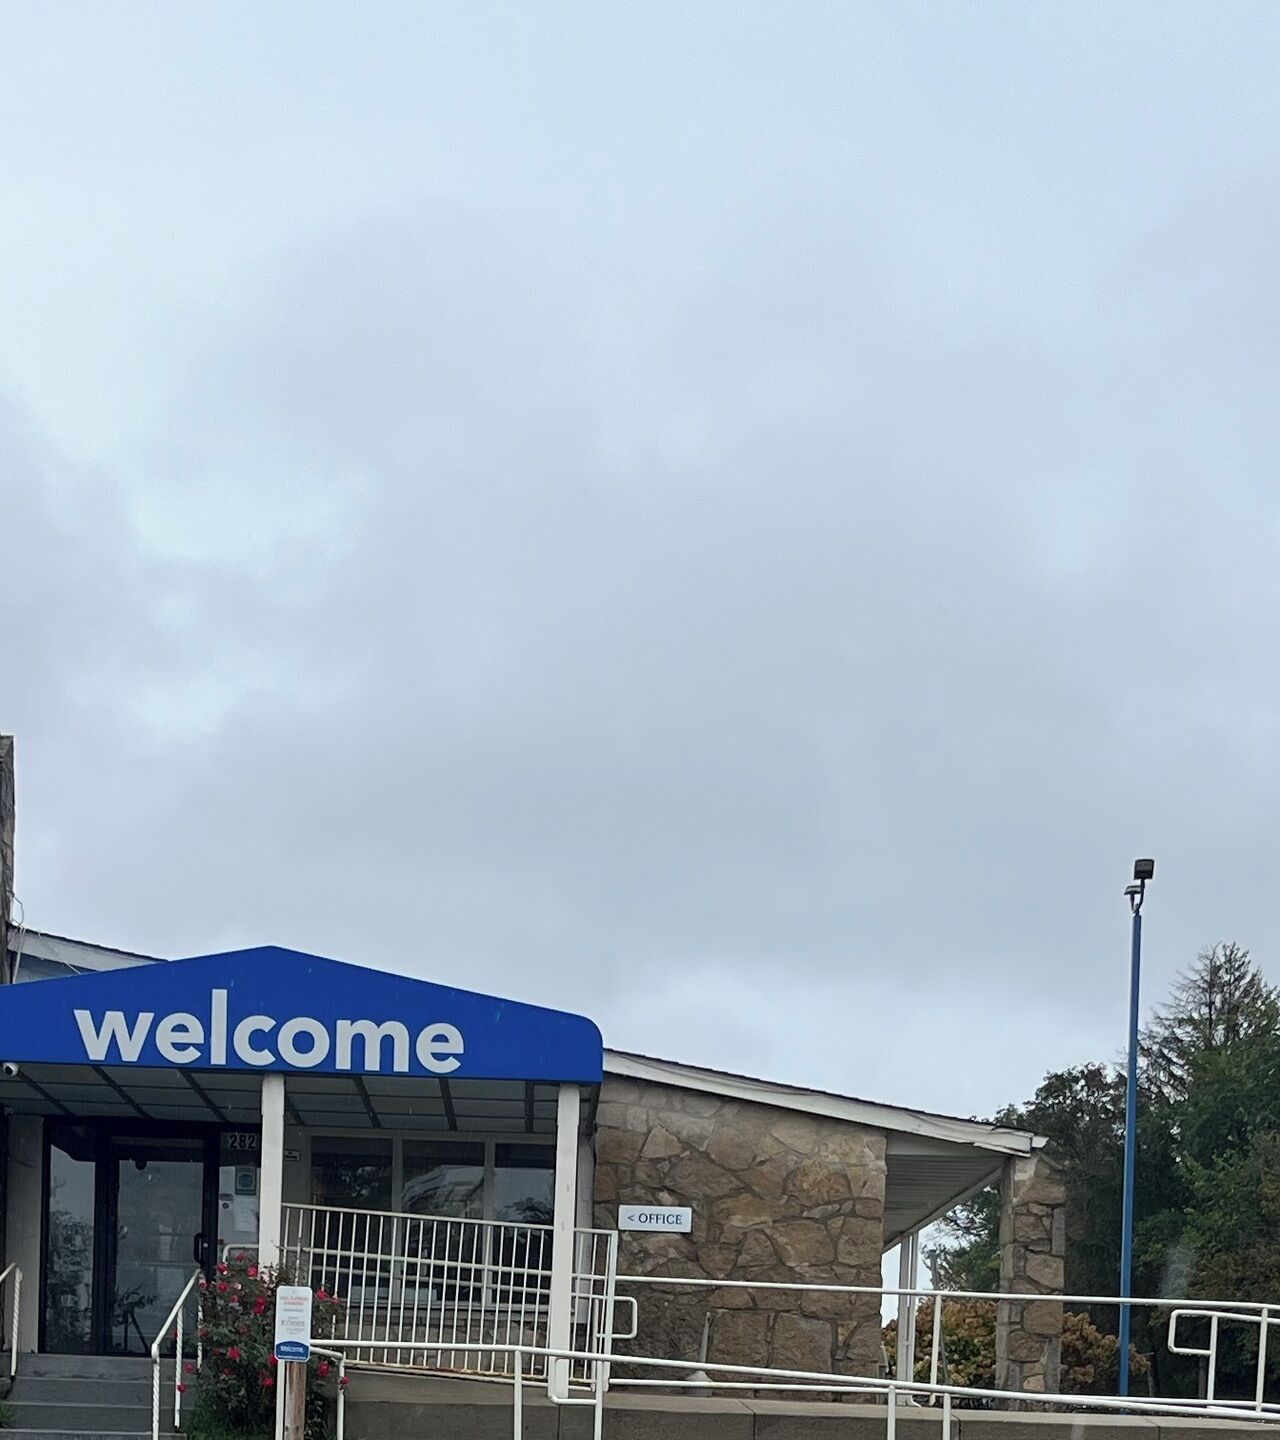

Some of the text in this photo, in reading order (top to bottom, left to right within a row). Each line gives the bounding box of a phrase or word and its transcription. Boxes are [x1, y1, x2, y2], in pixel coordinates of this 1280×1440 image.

[72, 988, 465, 1074] welcome
[230, 1134, 256, 1149] 282
[638, 1212, 683, 1225] OFFICE
